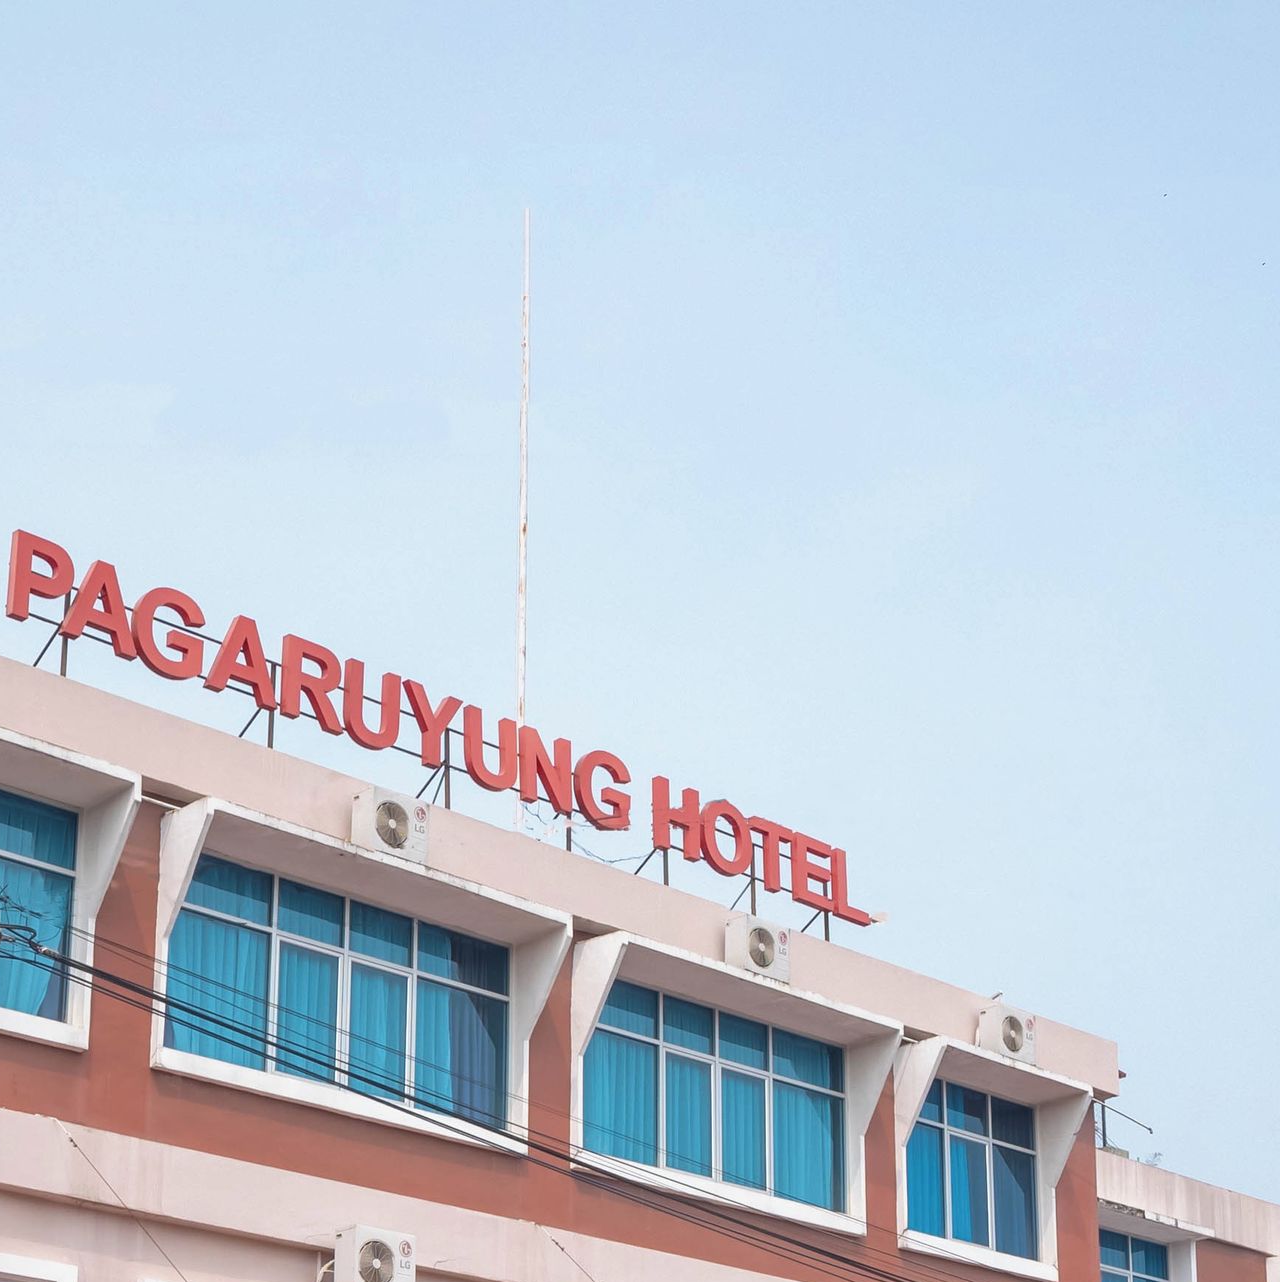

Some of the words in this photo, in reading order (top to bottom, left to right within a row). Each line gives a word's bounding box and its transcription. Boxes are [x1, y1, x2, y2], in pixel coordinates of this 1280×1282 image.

[6, 529, 631, 831] PAGARUYUNG
[651, 775, 872, 926] HOTEL
[414, 823, 425, 833] LG
[399, 1259, 411, 1270] LG
